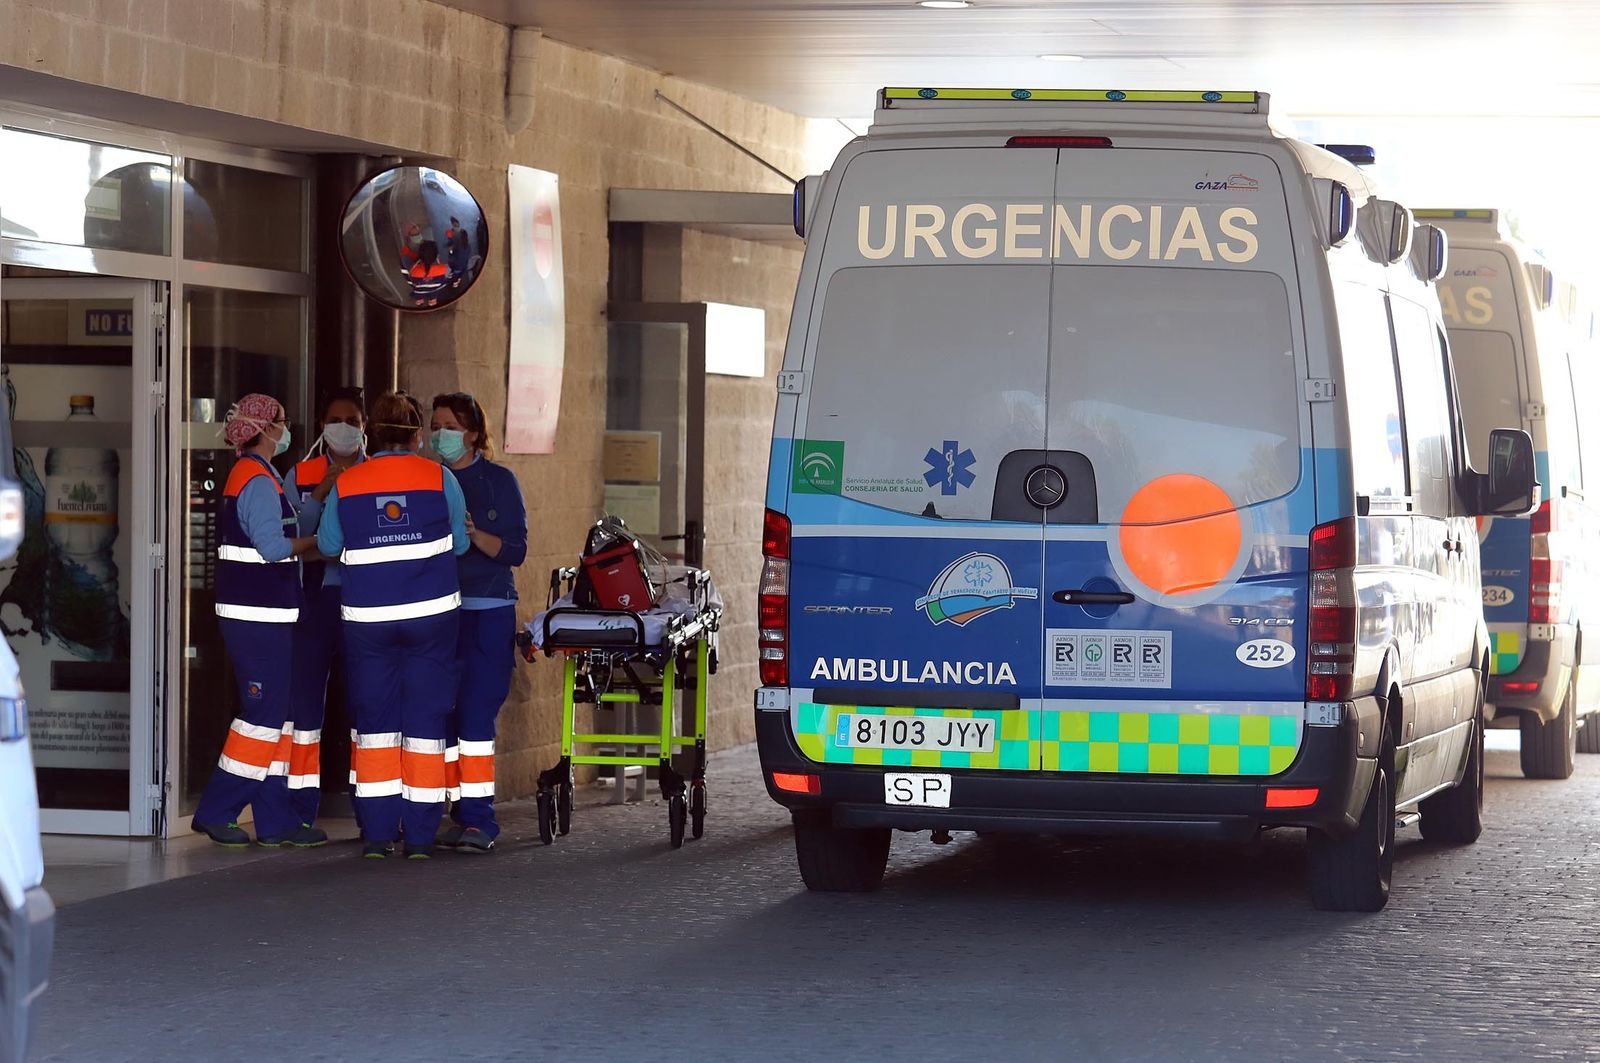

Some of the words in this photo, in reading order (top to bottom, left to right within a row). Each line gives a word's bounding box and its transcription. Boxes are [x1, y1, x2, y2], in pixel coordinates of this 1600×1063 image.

[1195, 181, 1227, 190] GAZA
[857, 203, 1258, 262] URGENCIAS
[89, 314, 111, 332] NO
[369, 532, 422, 544] URGENCIAS
[1482, 589, 1507, 602] 234
[803, 605, 893, 615] SPRINTER
[1227, 617, 1259, 626] 314
[1264, 618, 1295, 626] CDI
[1245, 645, 1285, 662] 252
[810, 657, 1017, 685] AMBULANCIA
[857, 719, 925, 745] 8103
[937, 722, 989, 747] JYY
